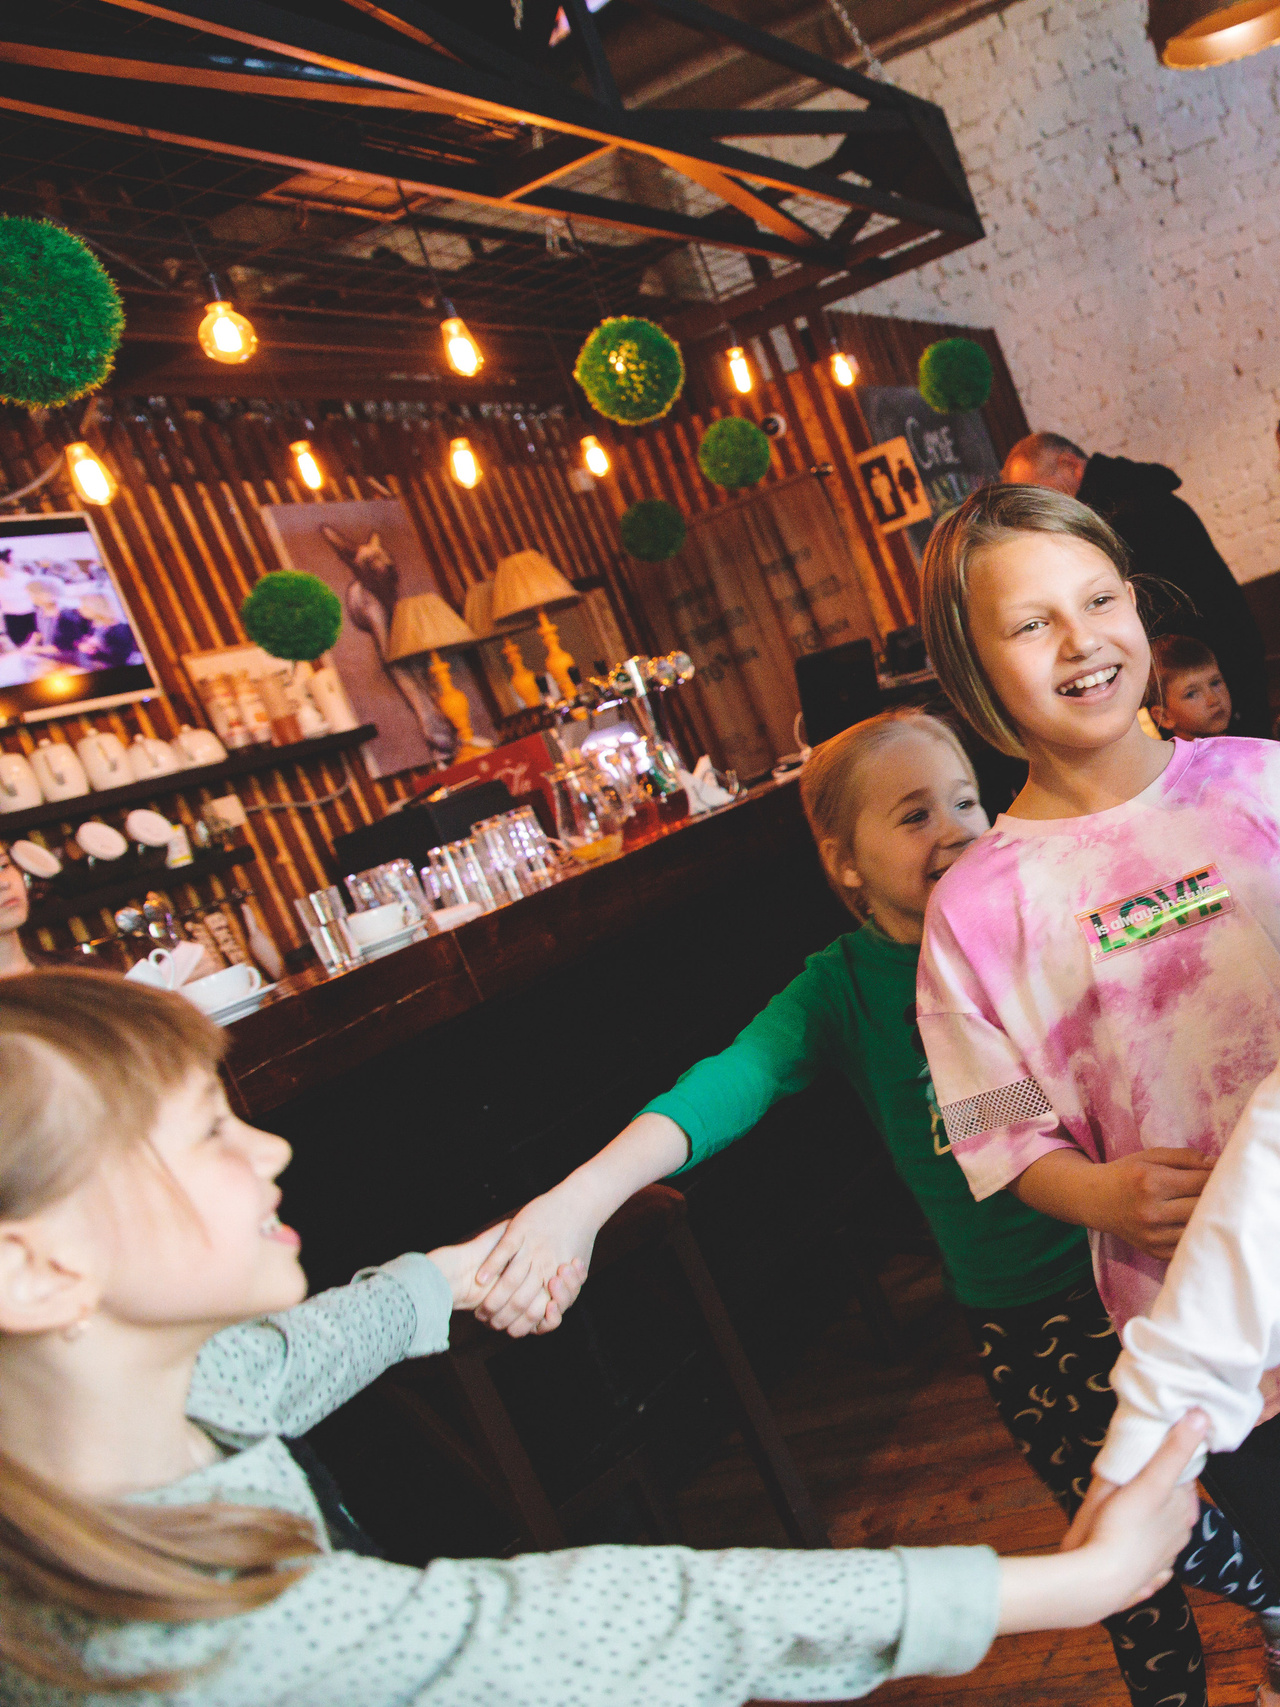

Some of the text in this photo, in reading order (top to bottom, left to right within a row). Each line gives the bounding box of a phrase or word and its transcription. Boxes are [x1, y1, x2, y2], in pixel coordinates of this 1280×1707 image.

[1090, 872, 1222, 953] LOVE
[1094, 884, 1213, 937] is always in style
